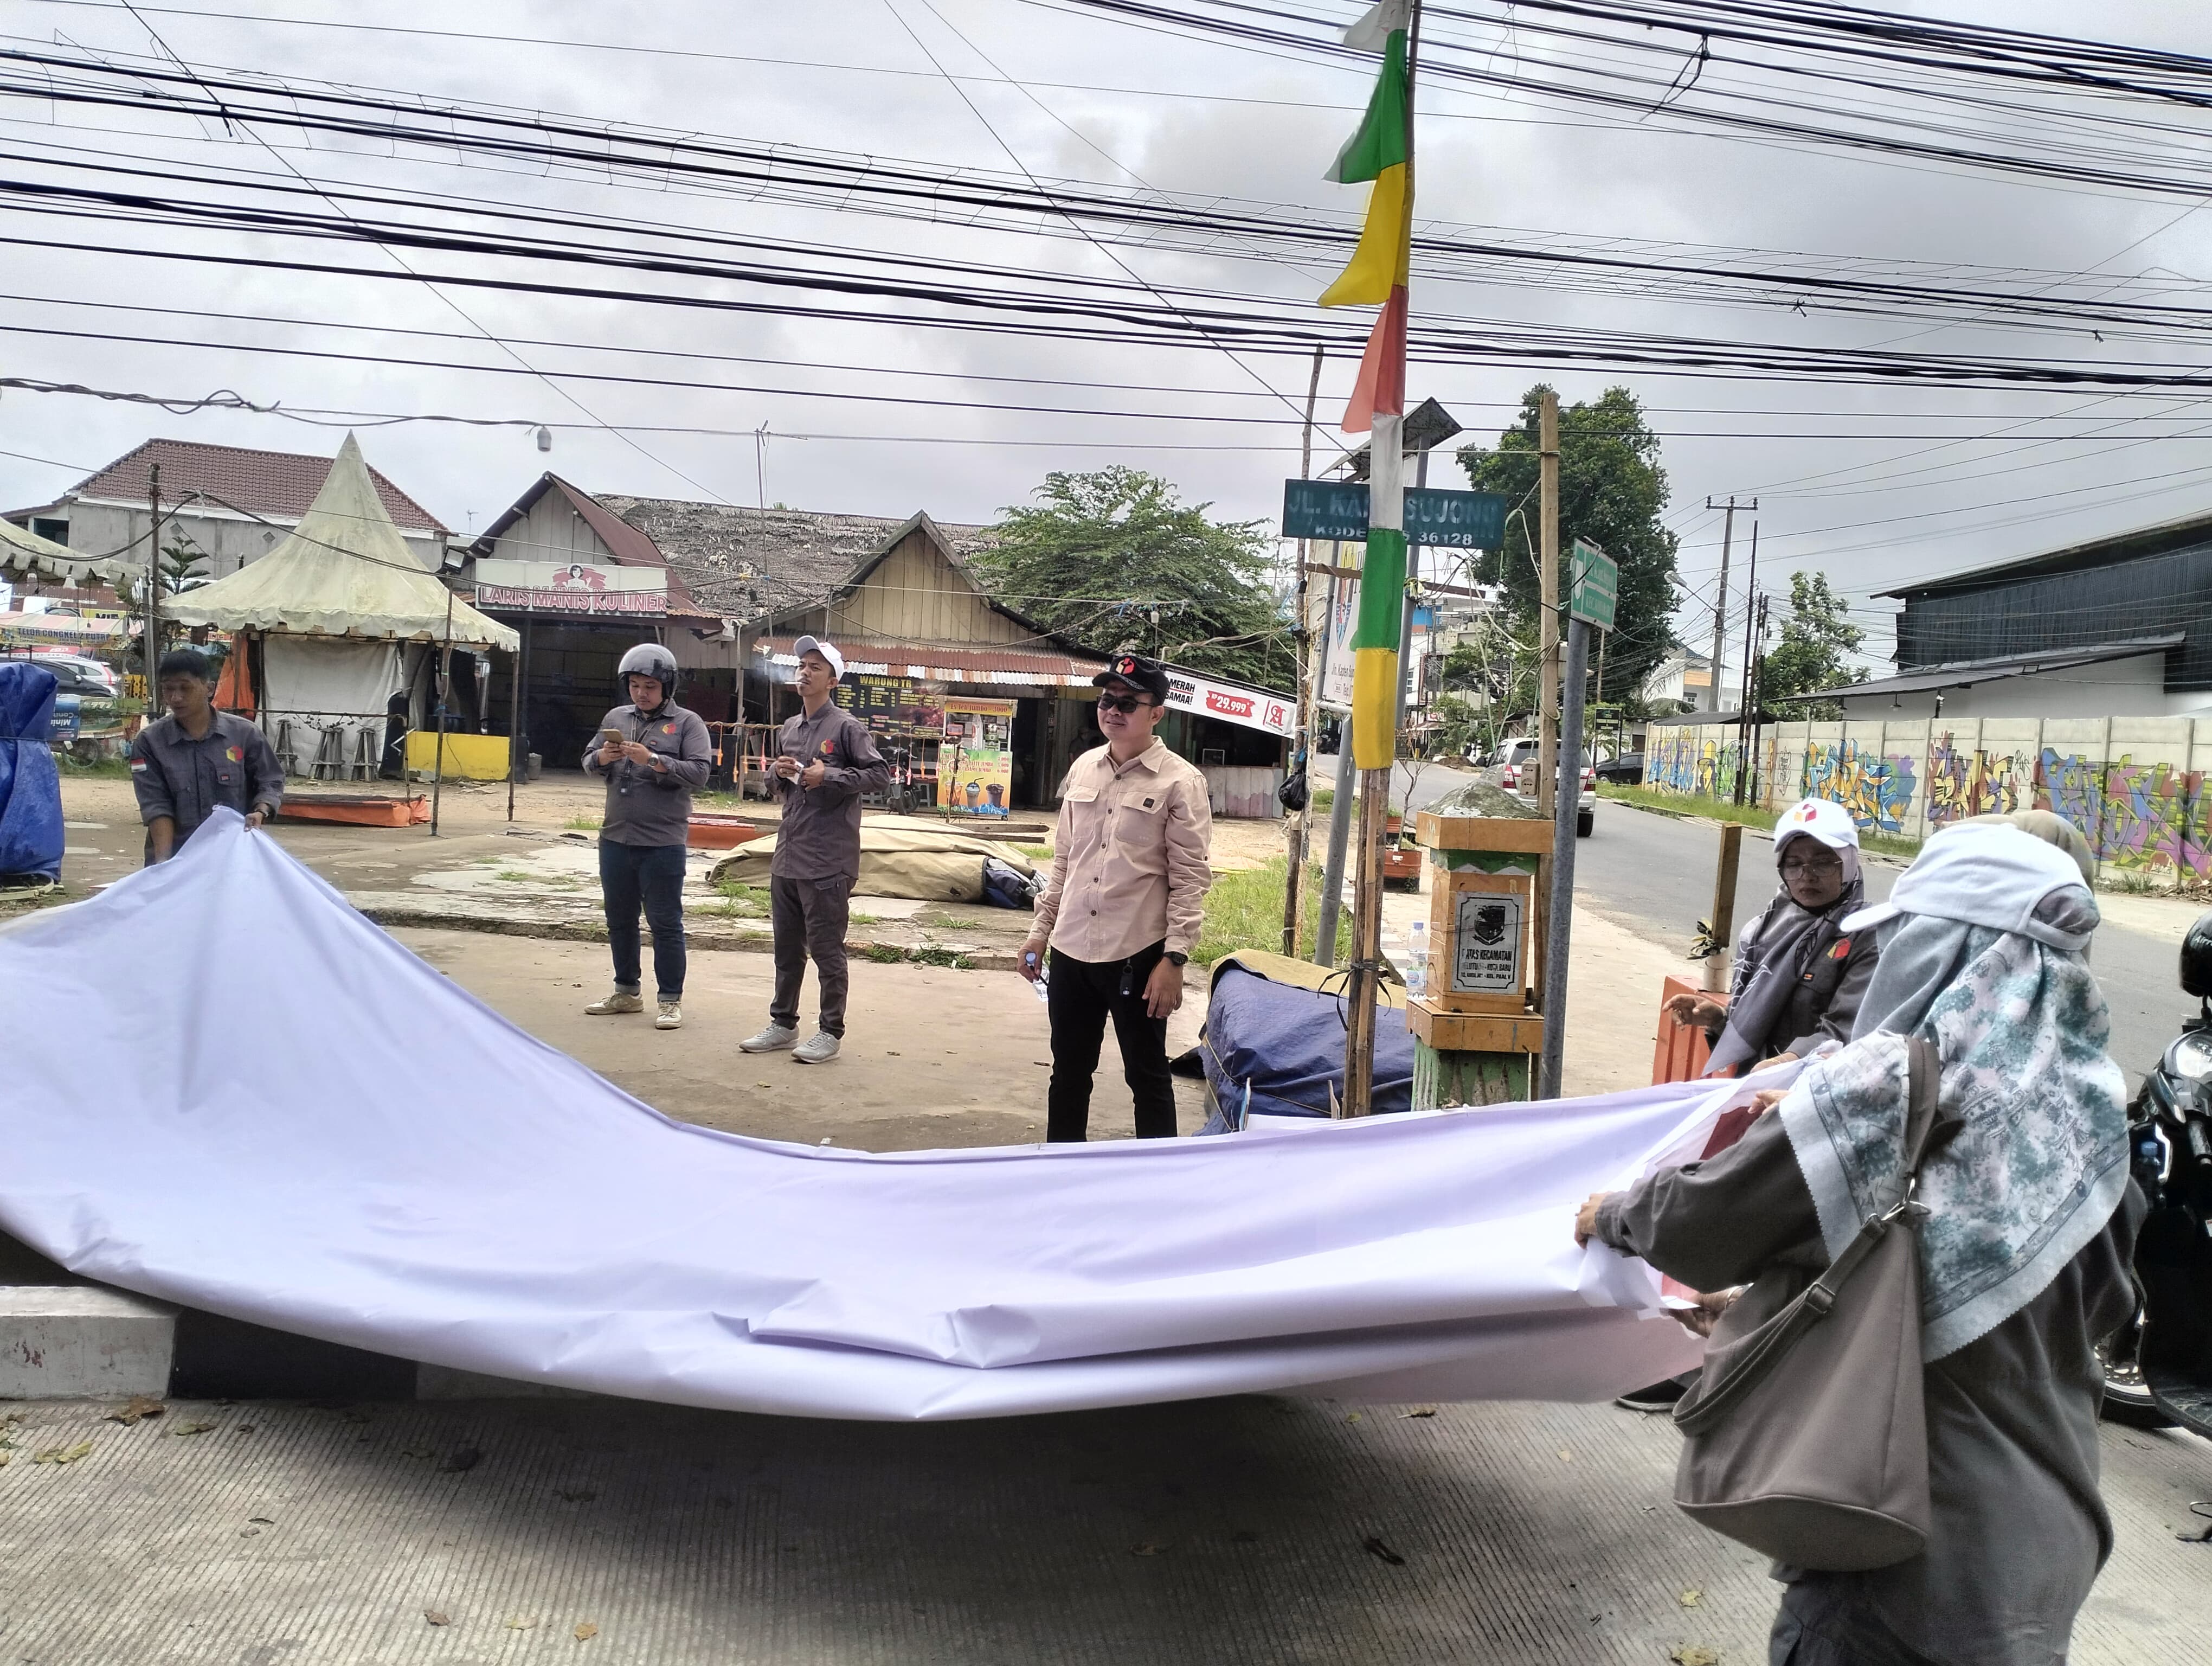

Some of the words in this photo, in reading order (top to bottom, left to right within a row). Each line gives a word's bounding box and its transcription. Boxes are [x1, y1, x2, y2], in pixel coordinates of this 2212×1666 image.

[1288, 490, 1321, 514] JL.
[1315, 525, 1366, 537] KODE
[1418, 531, 1472, 546] 36128
[479, 585, 531, 605] LARIS
[532, 585, 590, 610] MANIS
[593, 588, 667, 613] KULINER
[860, 676, 899, 687] WARUNG
[901, 679, 912, 688] TR
[1169, 678, 1195, 693] MERAH
[1165, 690, 1193, 706] SAMAA!
[1480, 950, 1512, 962] KECAMATAN
[1499, 964, 1511, 972] BARU
